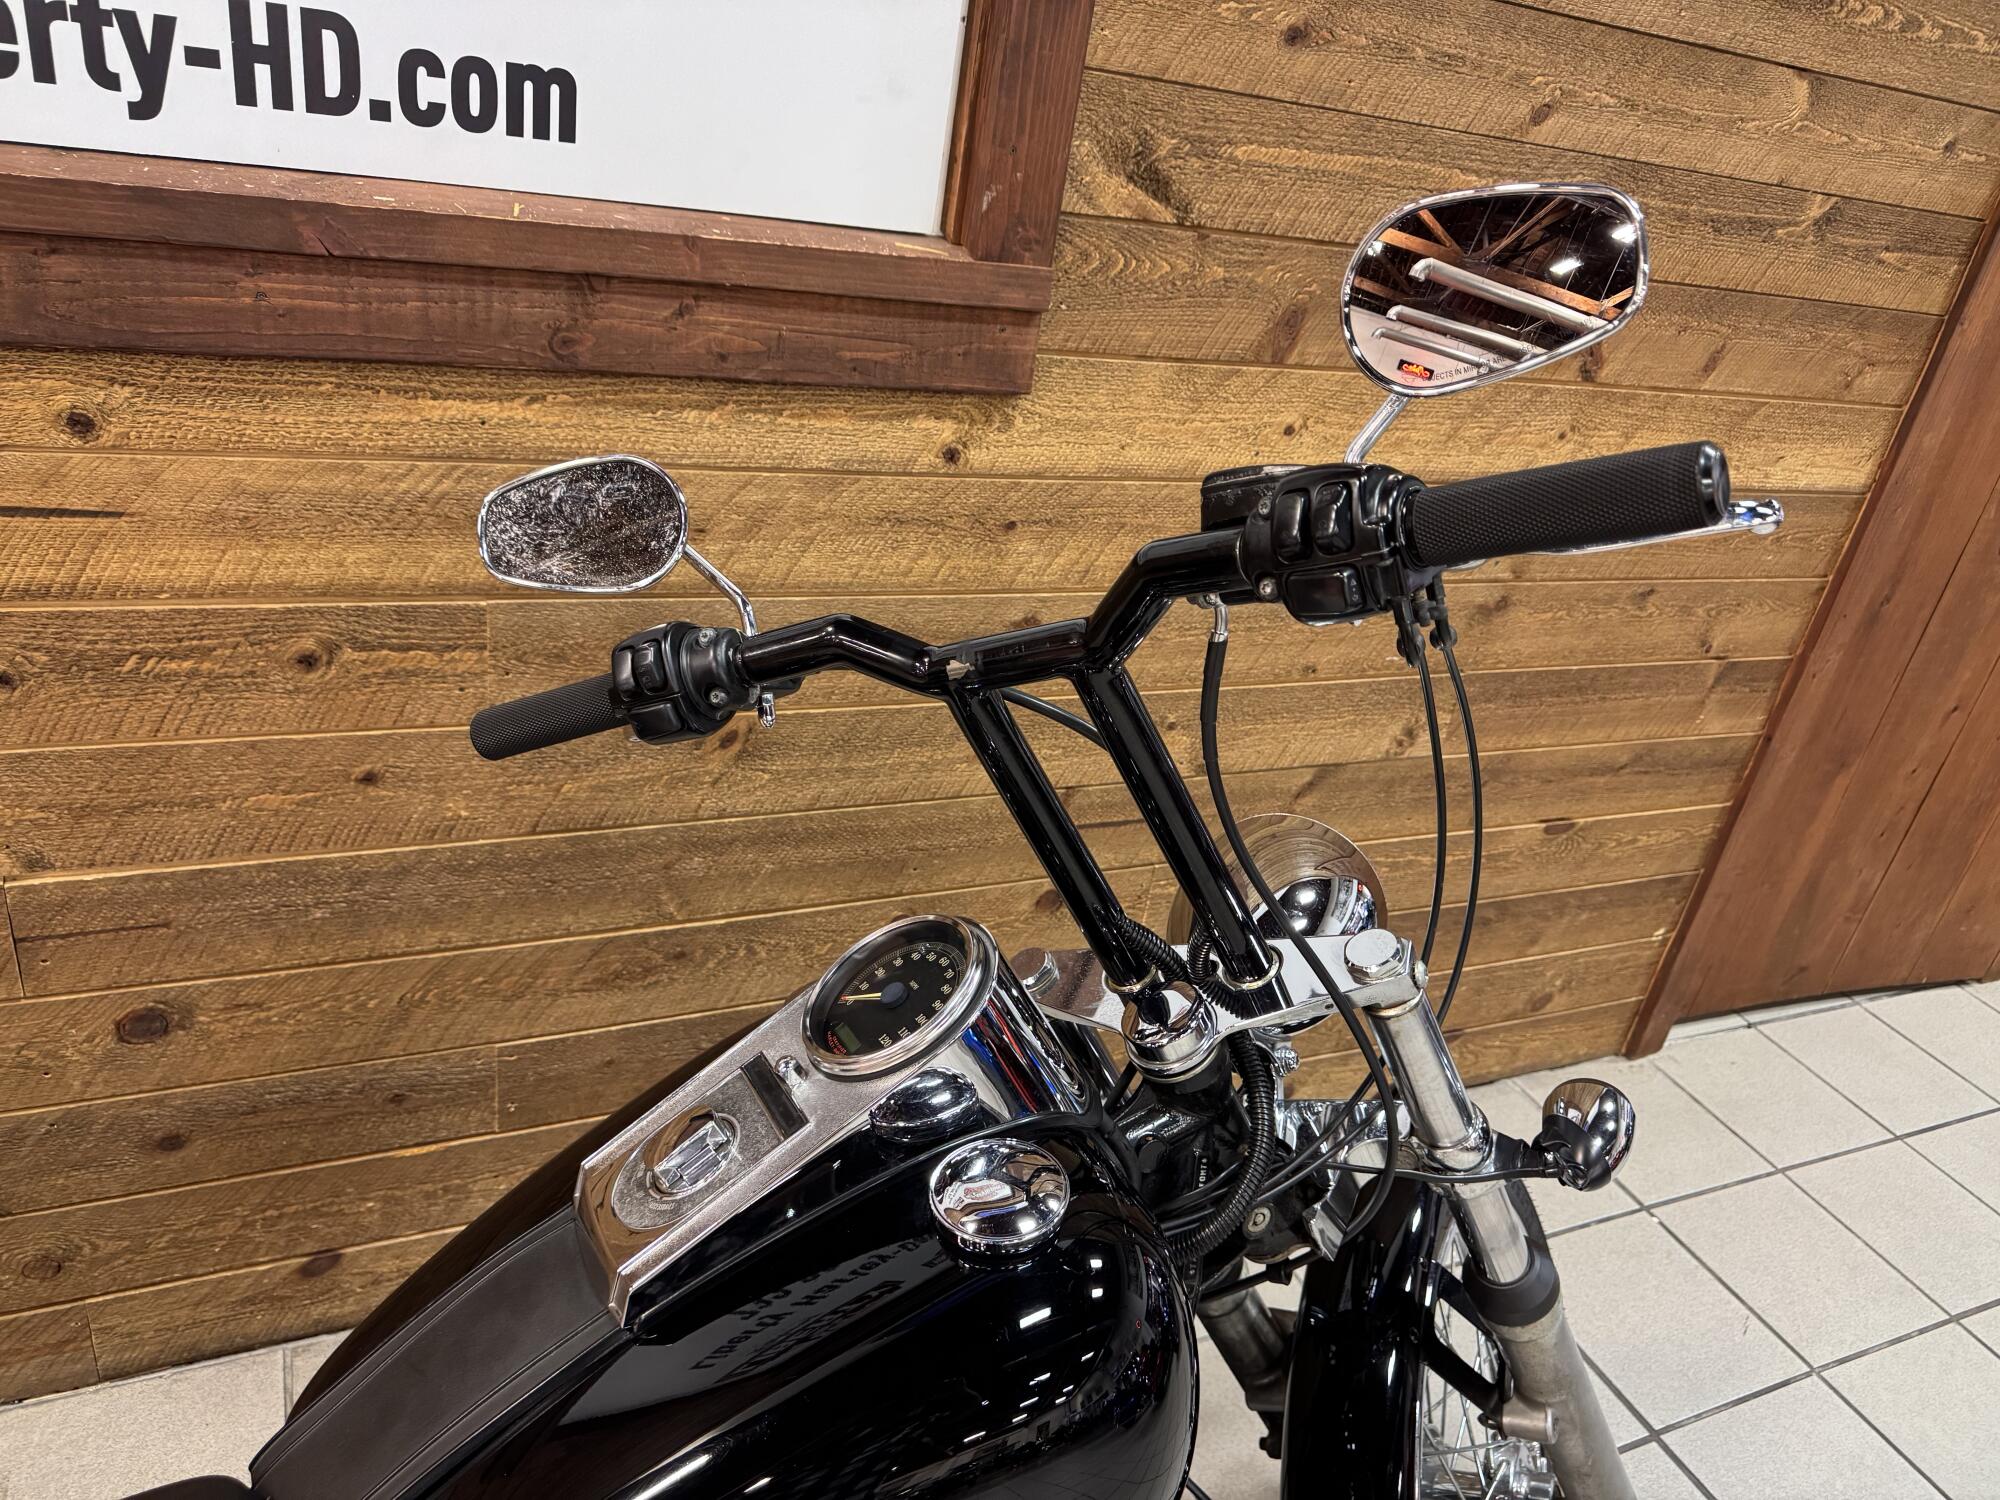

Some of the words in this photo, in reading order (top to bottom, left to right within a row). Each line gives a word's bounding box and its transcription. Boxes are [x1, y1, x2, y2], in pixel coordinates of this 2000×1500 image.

[911, 951, 921, 961] 40
[926, 951, 937, 962] 50
[938, 956, 950, 967] 60
[943, 968, 955, 979] 70
[859, 981, 870, 991] 10
[940, 983, 953, 995] 80
[932, 1000, 944, 1011] 90
[878, 1033, 893, 1048] 120
